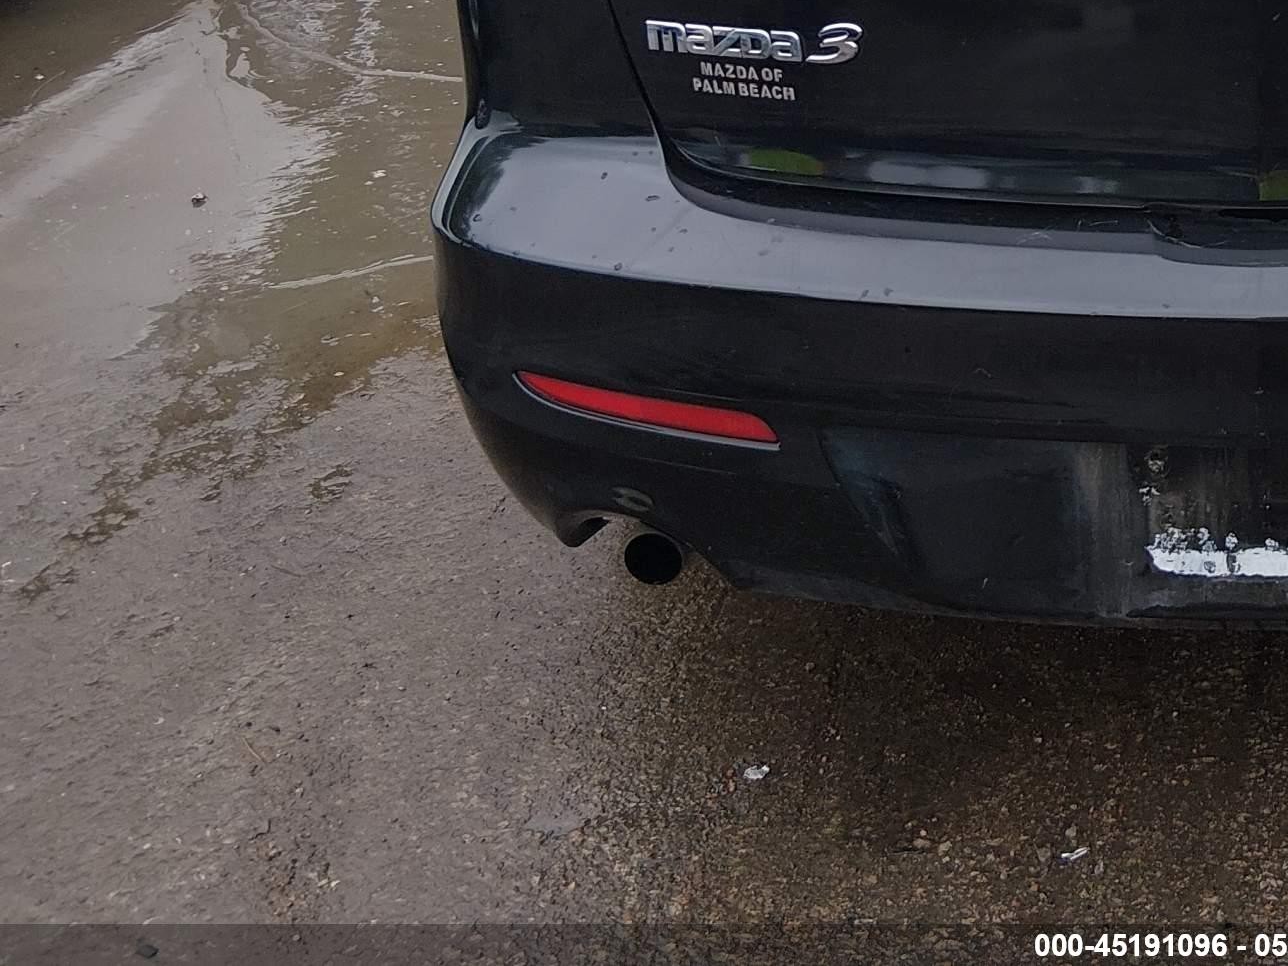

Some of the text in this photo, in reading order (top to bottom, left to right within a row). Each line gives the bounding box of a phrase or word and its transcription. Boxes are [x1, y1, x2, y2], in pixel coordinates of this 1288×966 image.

[805, 22, 864, 64] 3
[700, 61, 784, 83] MAZDA OF
[692, 77, 796, 101] PALM BEACH
